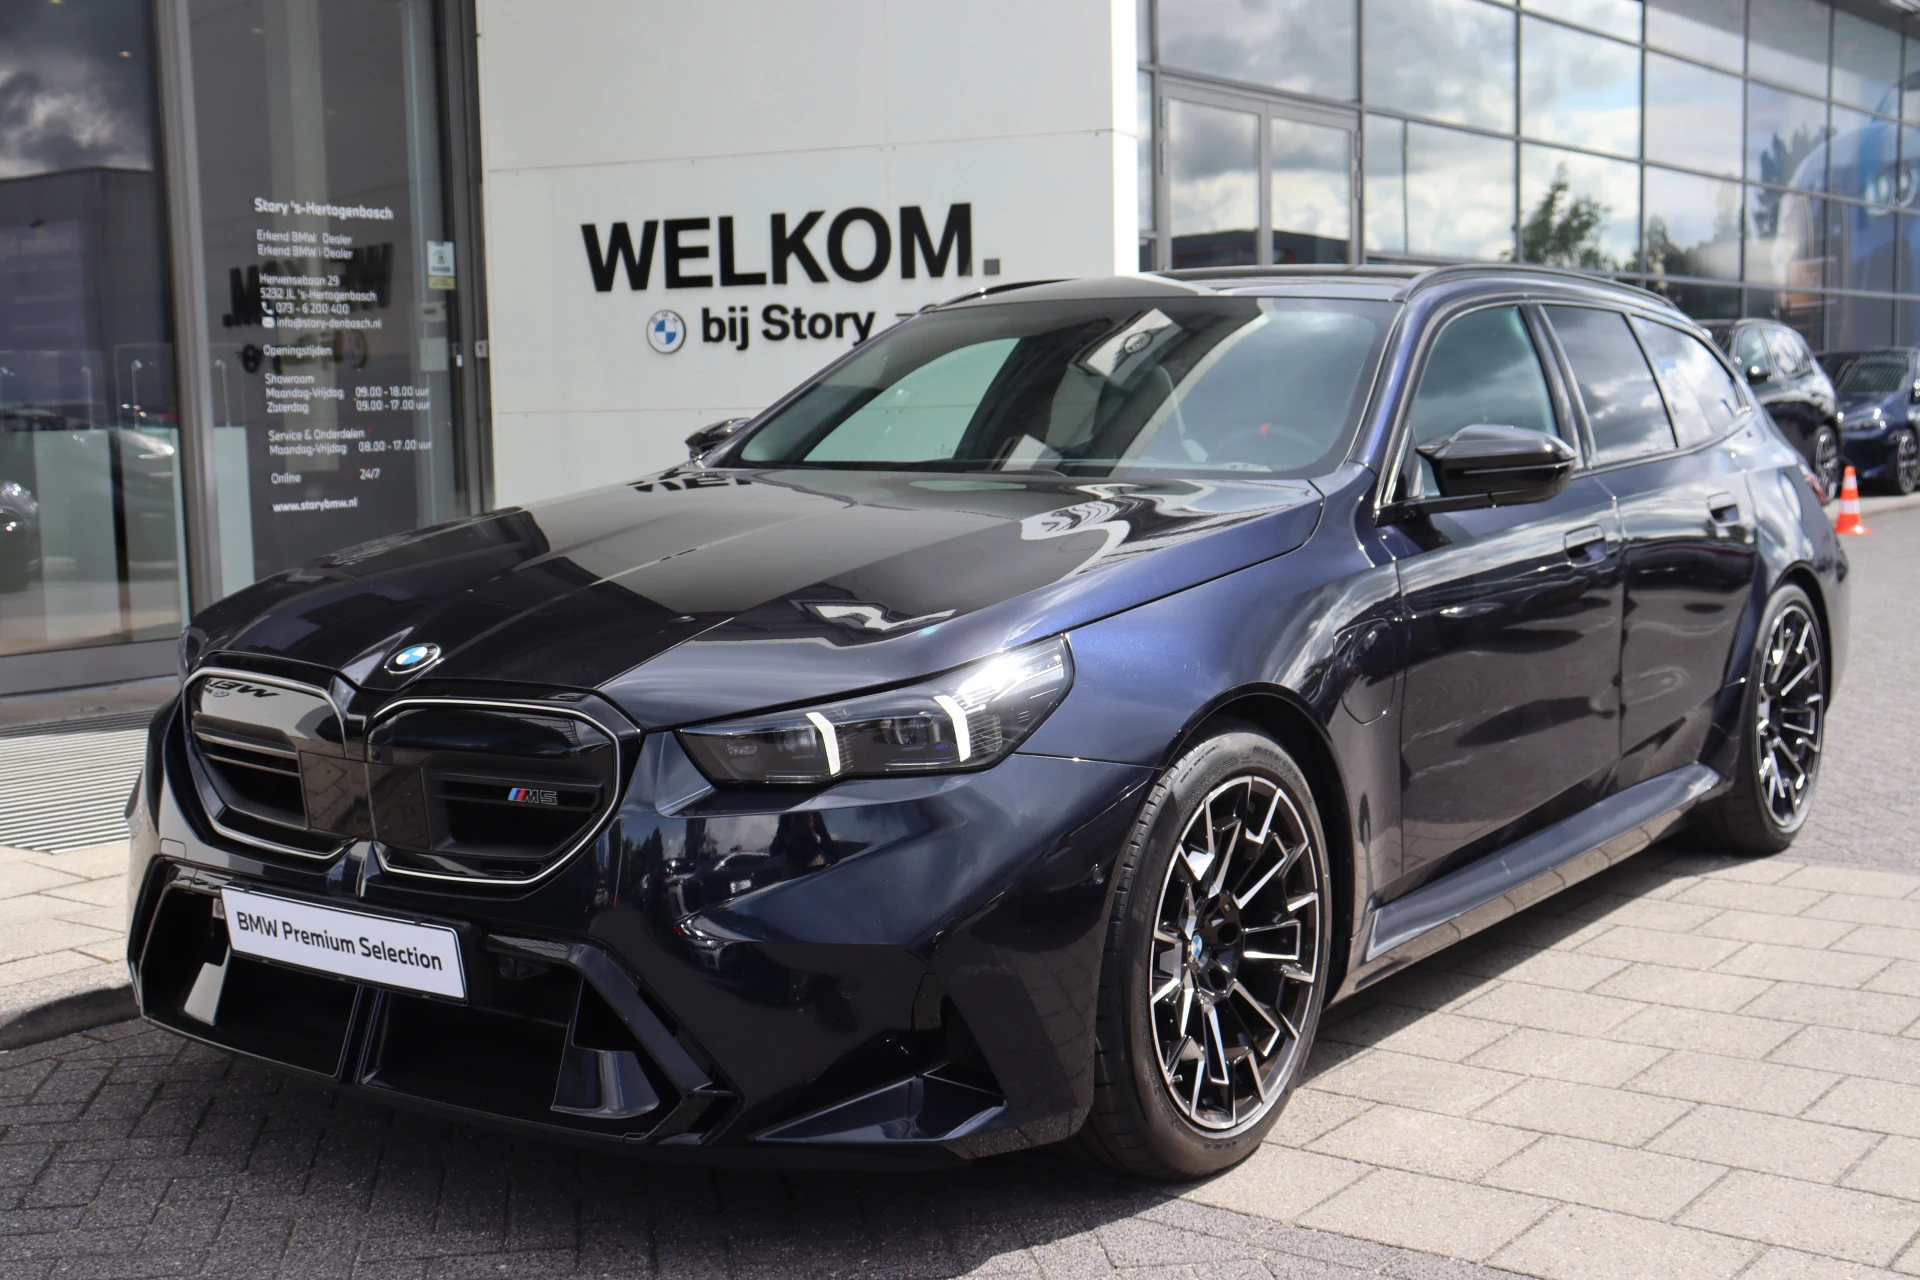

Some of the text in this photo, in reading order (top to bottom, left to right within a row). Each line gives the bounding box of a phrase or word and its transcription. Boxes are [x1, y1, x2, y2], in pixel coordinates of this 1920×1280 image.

[254, 197, 394, 221] Story 's-Hertogenbosch
[256, 229, 353, 246] Erkend BMW Dealer
[257, 244, 290, 257] Erkend
[292, 246, 317, 258] BMW
[323, 247, 353, 260] Dealer
[581, 202, 1000, 293] WELKOM.
[259, 273, 340, 287] Hervensebaan 29
[260, 287, 377, 302] 5232 JL 's-Hertogenbosch
[275, 303, 294, 314] 073
[302, 303, 309, 314] 6
[310, 303, 329, 314] 200
[330, 303, 349, 315] 400
[276, 318, 382, 330] info@story-denbosch.nl
[701, 304, 875, 350] bij Story
[262, 344, 332, 358] Openingstijden
[264, 373, 315, 384] Showroom
[265, 387, 345, 400] Maandag-Vrijdag
[355, 386, 382, 397] 09.00
[389, 385, 413, 396] 18.00
[414, 386, 430, 396] uur
[266, 402, 309, 414] Zaterdag
[356, 400, 382, 411] 09.00
[415, 401, 430, 410] uur
[268, 429, 365, 441] Service & Onderdelen
[269, 443, 348, 456] Maandag-Vrijdag
[358, 441, 385, 451] 08.00
[392, 440, 416, 450] 17.00
[417, 441, 432, 449] uur
[271, 468, 380, 484] Online 24/7
[272, 497, 358, 512] www.storybmw.nl
[236, 911, 443, 971] BMW Premium Selection
